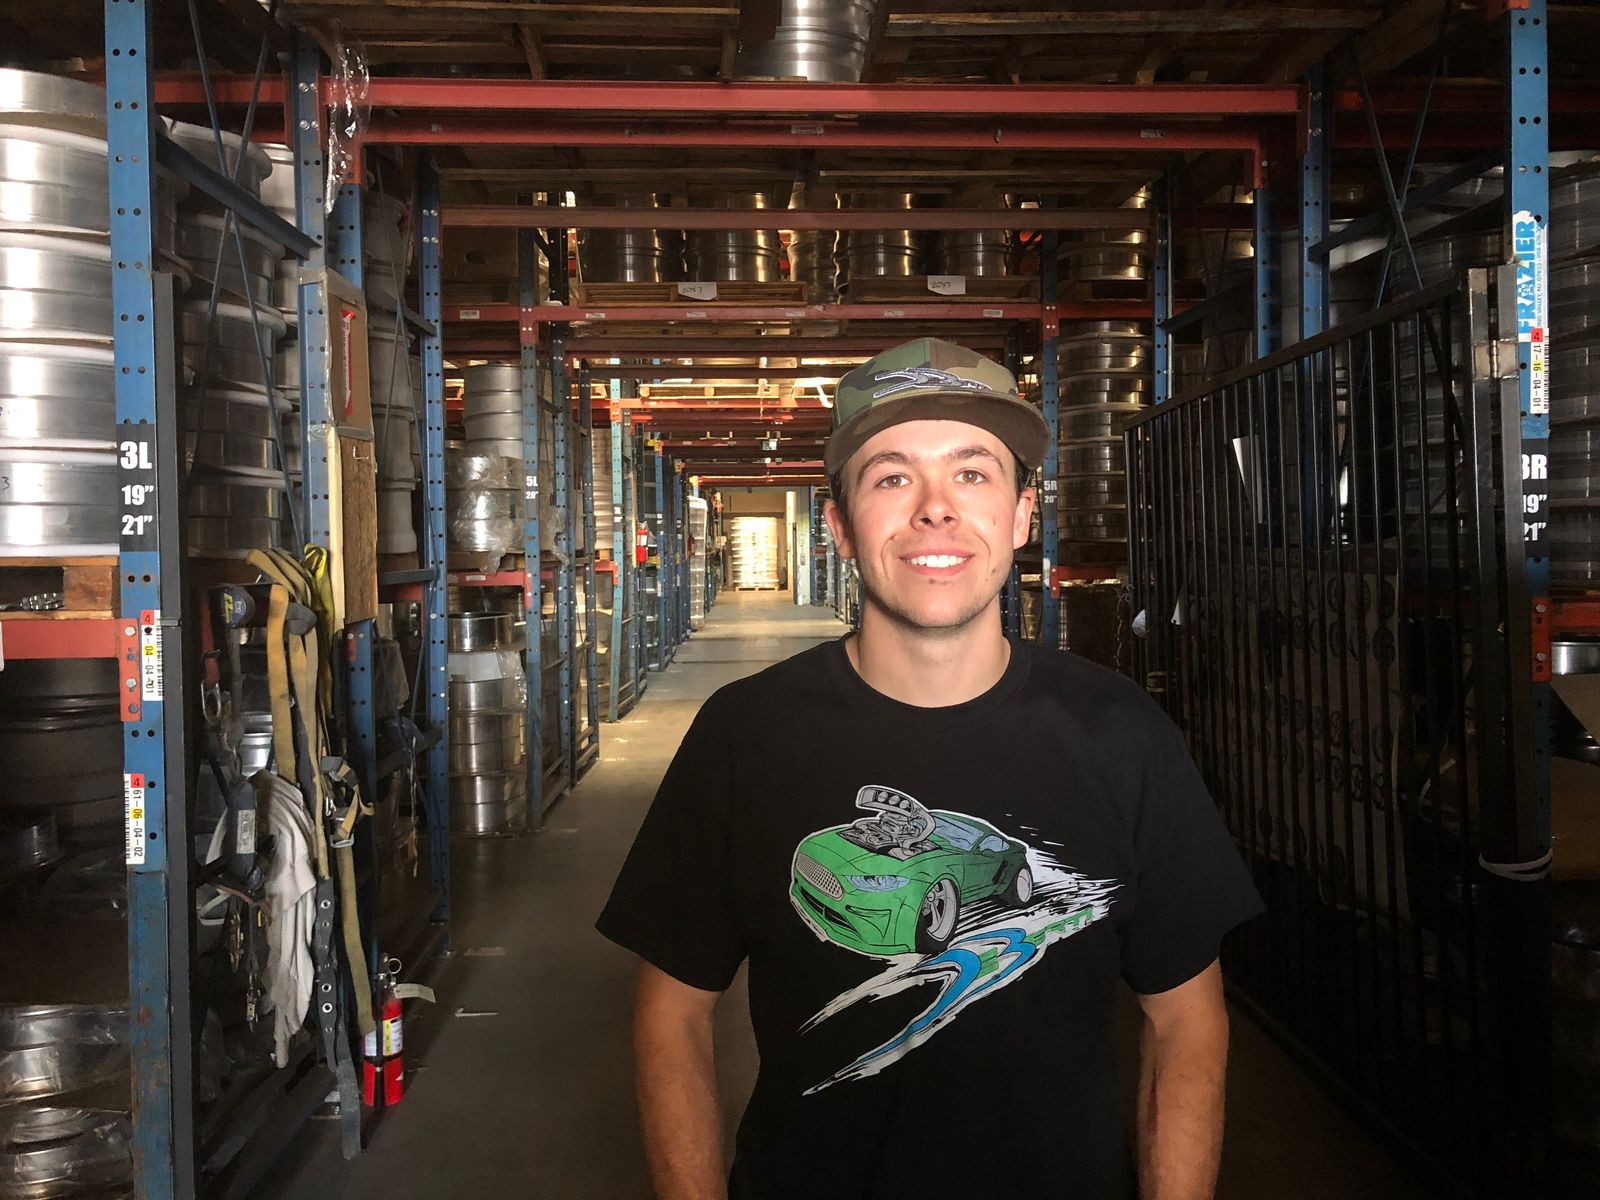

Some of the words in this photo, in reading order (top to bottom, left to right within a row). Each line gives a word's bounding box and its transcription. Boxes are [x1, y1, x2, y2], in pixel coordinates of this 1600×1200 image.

[1515, 221, 1536, 334] FRAZIER
[120, 441, 153, 470] 3L
[526, 475, 539, 487] 5L
[133, 778, 141, 787] 4
